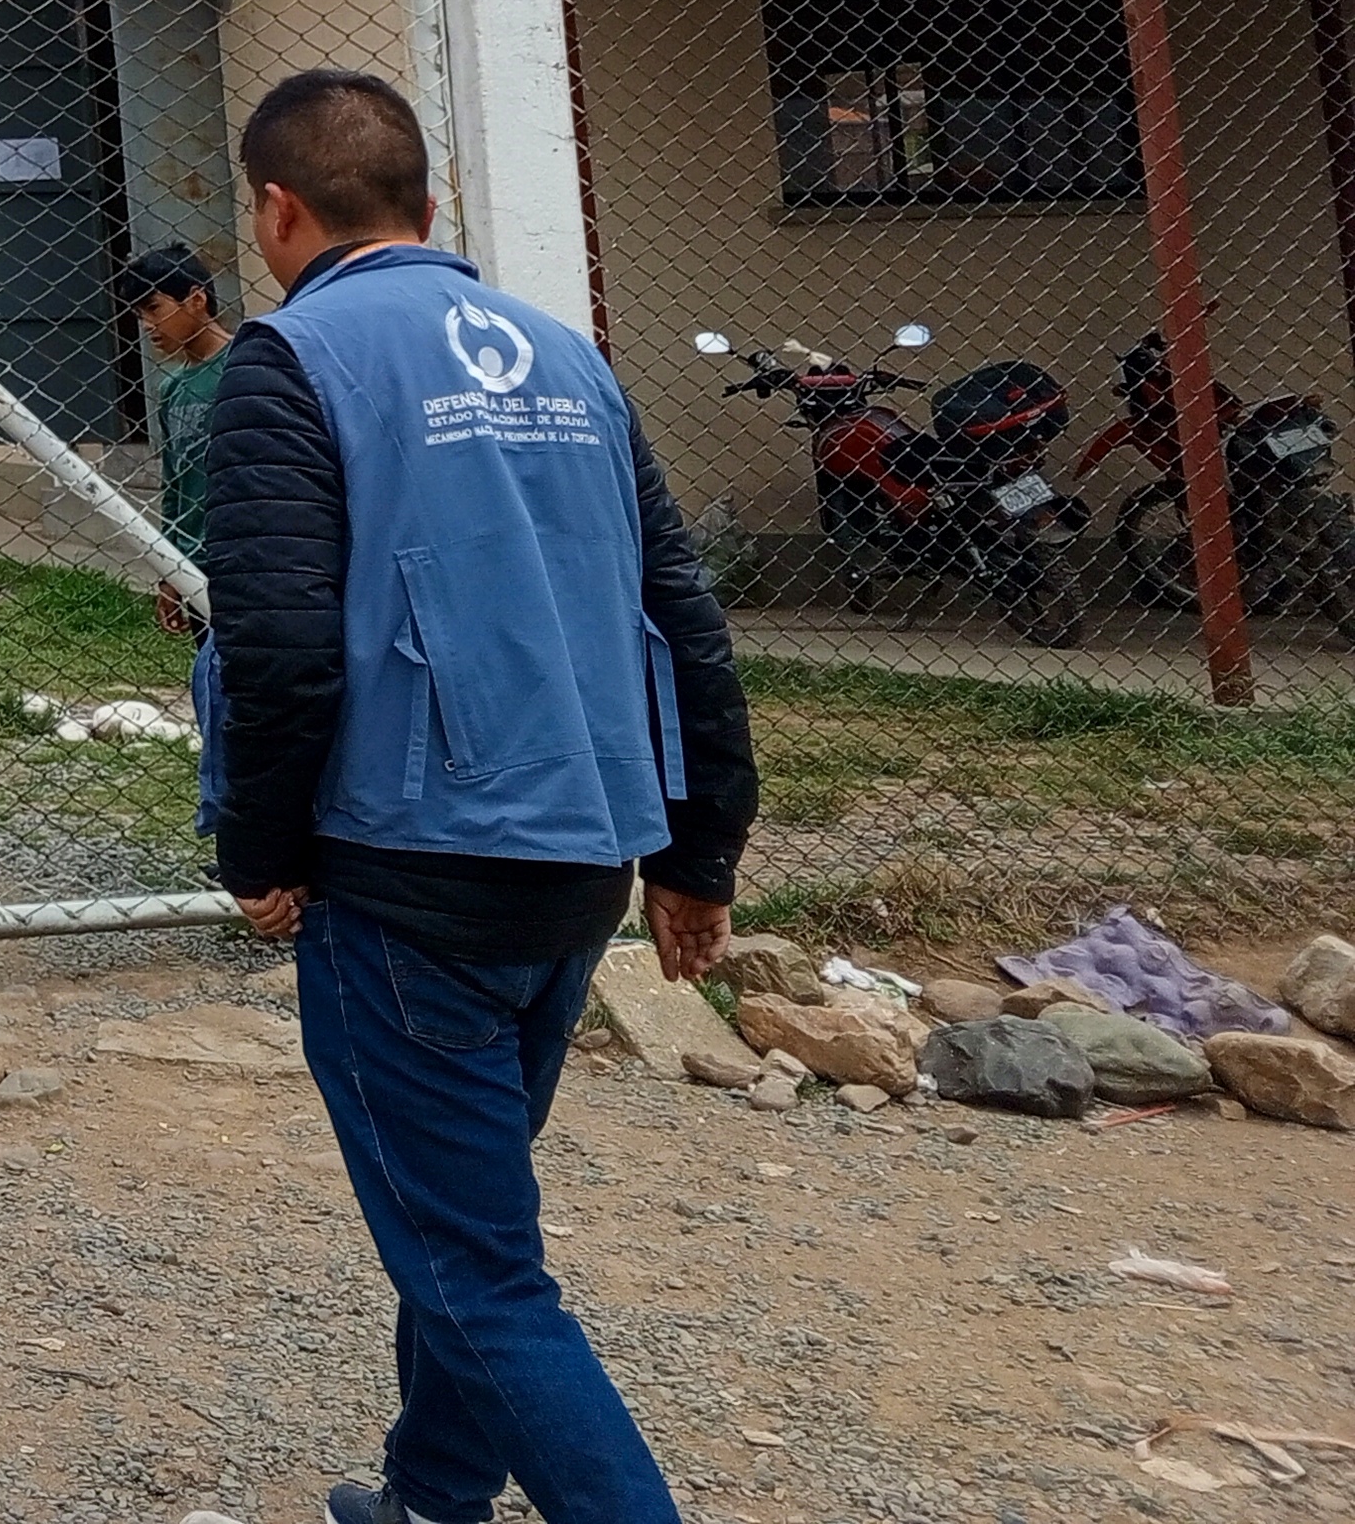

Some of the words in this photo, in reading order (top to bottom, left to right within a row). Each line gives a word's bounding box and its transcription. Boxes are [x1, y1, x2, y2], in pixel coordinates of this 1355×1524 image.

[503, 397, 530, 413] DEL
[536, 396, 586, 415] PUEBLO
[427, 410, 473, 428] ESTADO
[536, 415, 551, 425] DE
